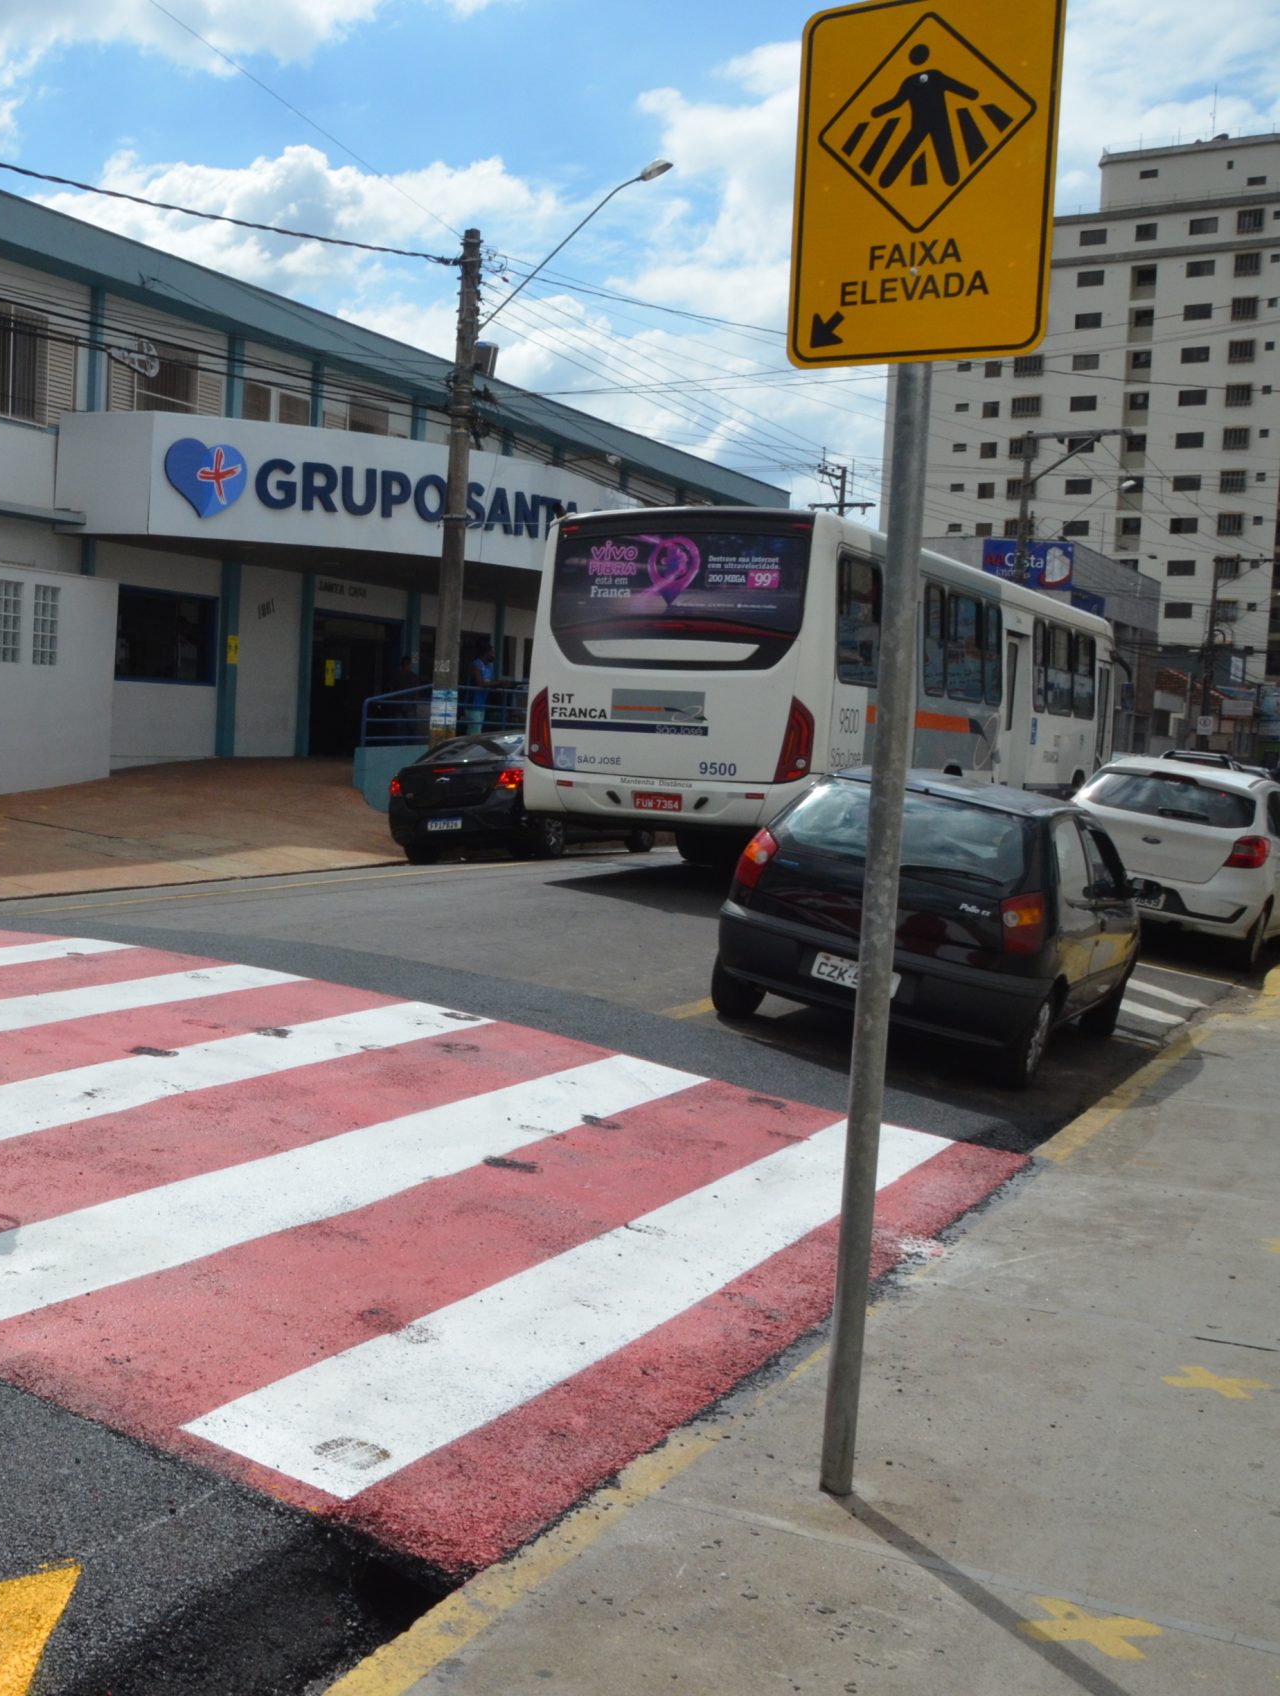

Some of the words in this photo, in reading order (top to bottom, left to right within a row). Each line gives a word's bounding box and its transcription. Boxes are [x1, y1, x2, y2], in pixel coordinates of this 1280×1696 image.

[869, 238, 962, 271] FAIXA
[840, 270, 990, 307] ELEVADA
[255, 458, 447, 523] GRUPO
[591, 540, 638, 560] vivo
[1004, 552, 1044, 568] Csta
[589, 561, 637, 576] FIBRA
[595, 576, 613, 585] está
[615, 577, 629, 585] em
[708, 574, 723, 583] 200
[724, 574, 746, 583] MEGA
[590, 586, 631, 598] Franca
[552, 693, 574, 704] SIT
[551, 706, 607, 719] FRANCA
[839, 708, 860, 734] 9500
[577, 754, 593, 765] SÃO
[596, 754, 621, 766] JOSÉ
[699, 761, 737, 777] 9500
[620, 777, 655, 786] Mantenha
[659, 779, 693, 789] Distância
